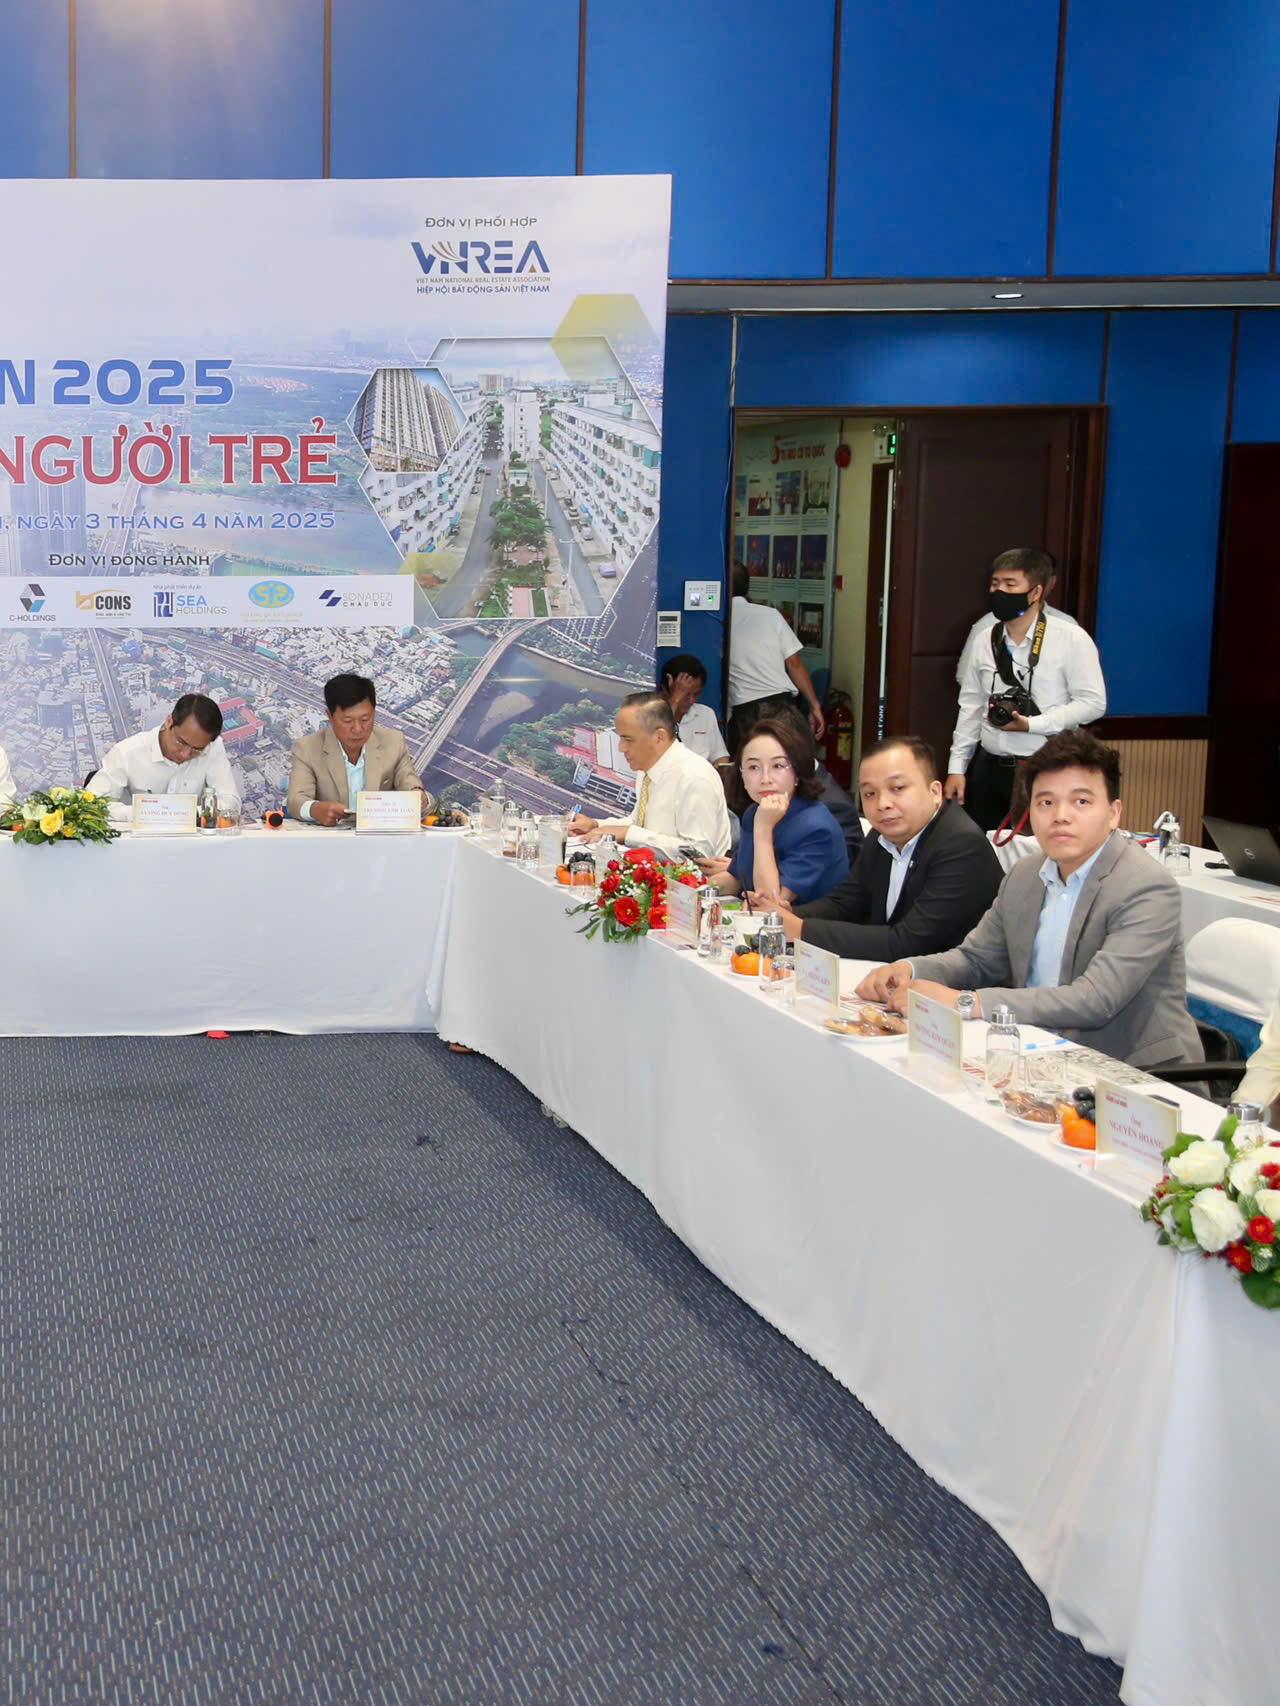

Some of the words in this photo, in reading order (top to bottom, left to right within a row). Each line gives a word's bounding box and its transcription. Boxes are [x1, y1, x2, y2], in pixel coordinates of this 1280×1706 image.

[425, 217, 455, 228] ĐƠN
[458, 218, 471, 229] VỊ
[475, 214, 506, 227] PHỐI
[510, 216, 538, 229] HỢP
[410, 240, 550, 275] VNREA
[416, 284, 433, 295] HIỆP
[435, 284, 450, 295] HỘI
[452, 284, 465, 293] BẤT
[467, 284, 493, 294] ĐỘNG
[495, 283, 510, 293] SẢN
[512, 284, 529, 294] VIỆT
[530, 285, 550, 293] NAM
[52, 359, 234, 405] 2025
[209, 417, 337, 486] TRẺ
[18, 512, 80, 529] NGÀY
[85, 513, 100, 529] 3
[107, 511, 185, 529] THÁNG
[192, 513, 207, 529] 4
[214, 512, 263, 529] NĂM
[271, 512, 336, 529] 2025
[48, 553, 86, 566] ĐƠN
[92, 555, 106, 569] VỊ
[111, 551, 158, 566] ĐỒNG
[163, 551, 210, 566] HÀNH
[176, 595, 208, 606] SEA
[342, 592, 393, 601] SONADEZI
[9, 614, 56, 622] C-HOLDINGS
[175, 606, 227, 615] HOLDINGS
